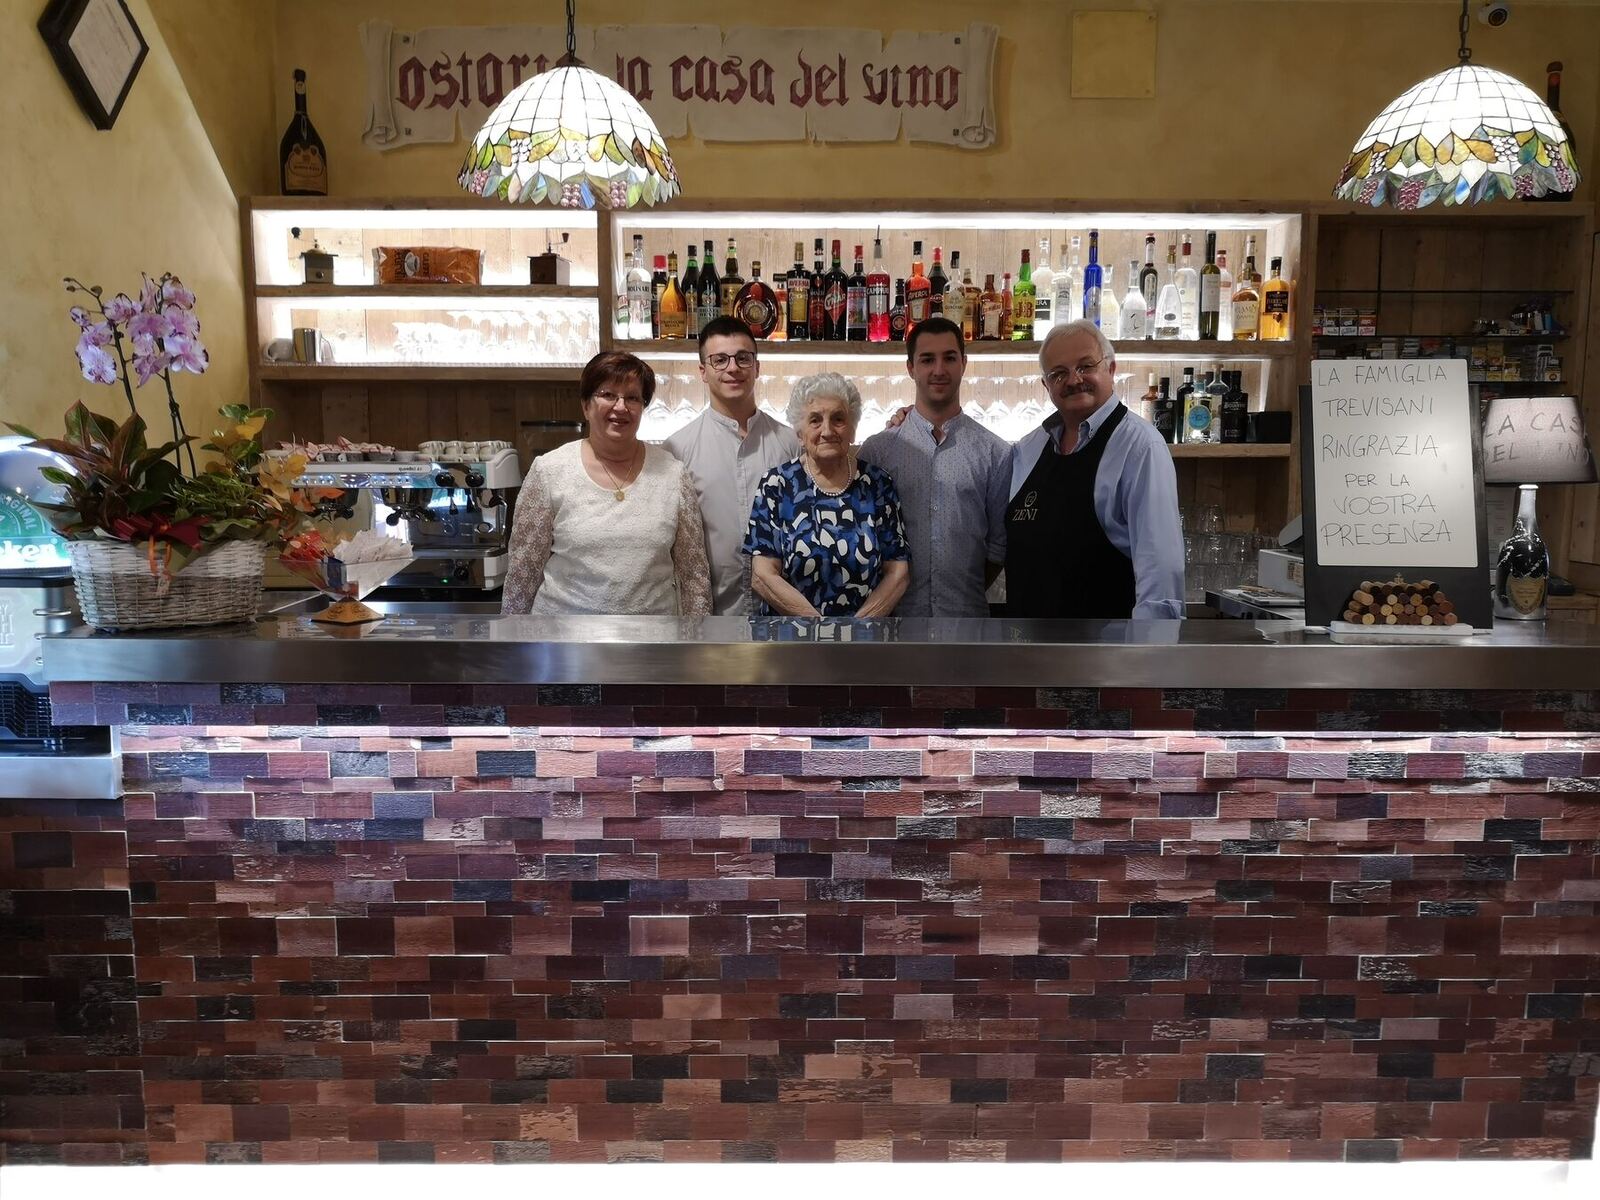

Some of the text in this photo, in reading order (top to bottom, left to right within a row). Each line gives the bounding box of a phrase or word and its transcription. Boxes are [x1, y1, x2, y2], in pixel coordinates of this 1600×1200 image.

[396, 50, 586, 112] ostar
[669, 55, 776, 106] casa
[790, 48, 850, 108] del
[862, 63, 962, 111] vino
[1318, 364, 1448, 387] LA FAMIGLIA
[1321, 394, 1434, 417] TREVISANI
[1530, 411, 1582, 436] CAS
[1322, 434, 1440, 461] RINGRAZIA
[1344, 472, 1411, 488] PER LA
[1012, 508, 1039, 521] ZENI
[1333, 493, 1437, 516] VOSTRA
[1320, 519, 1453, 547] PRESENZA
